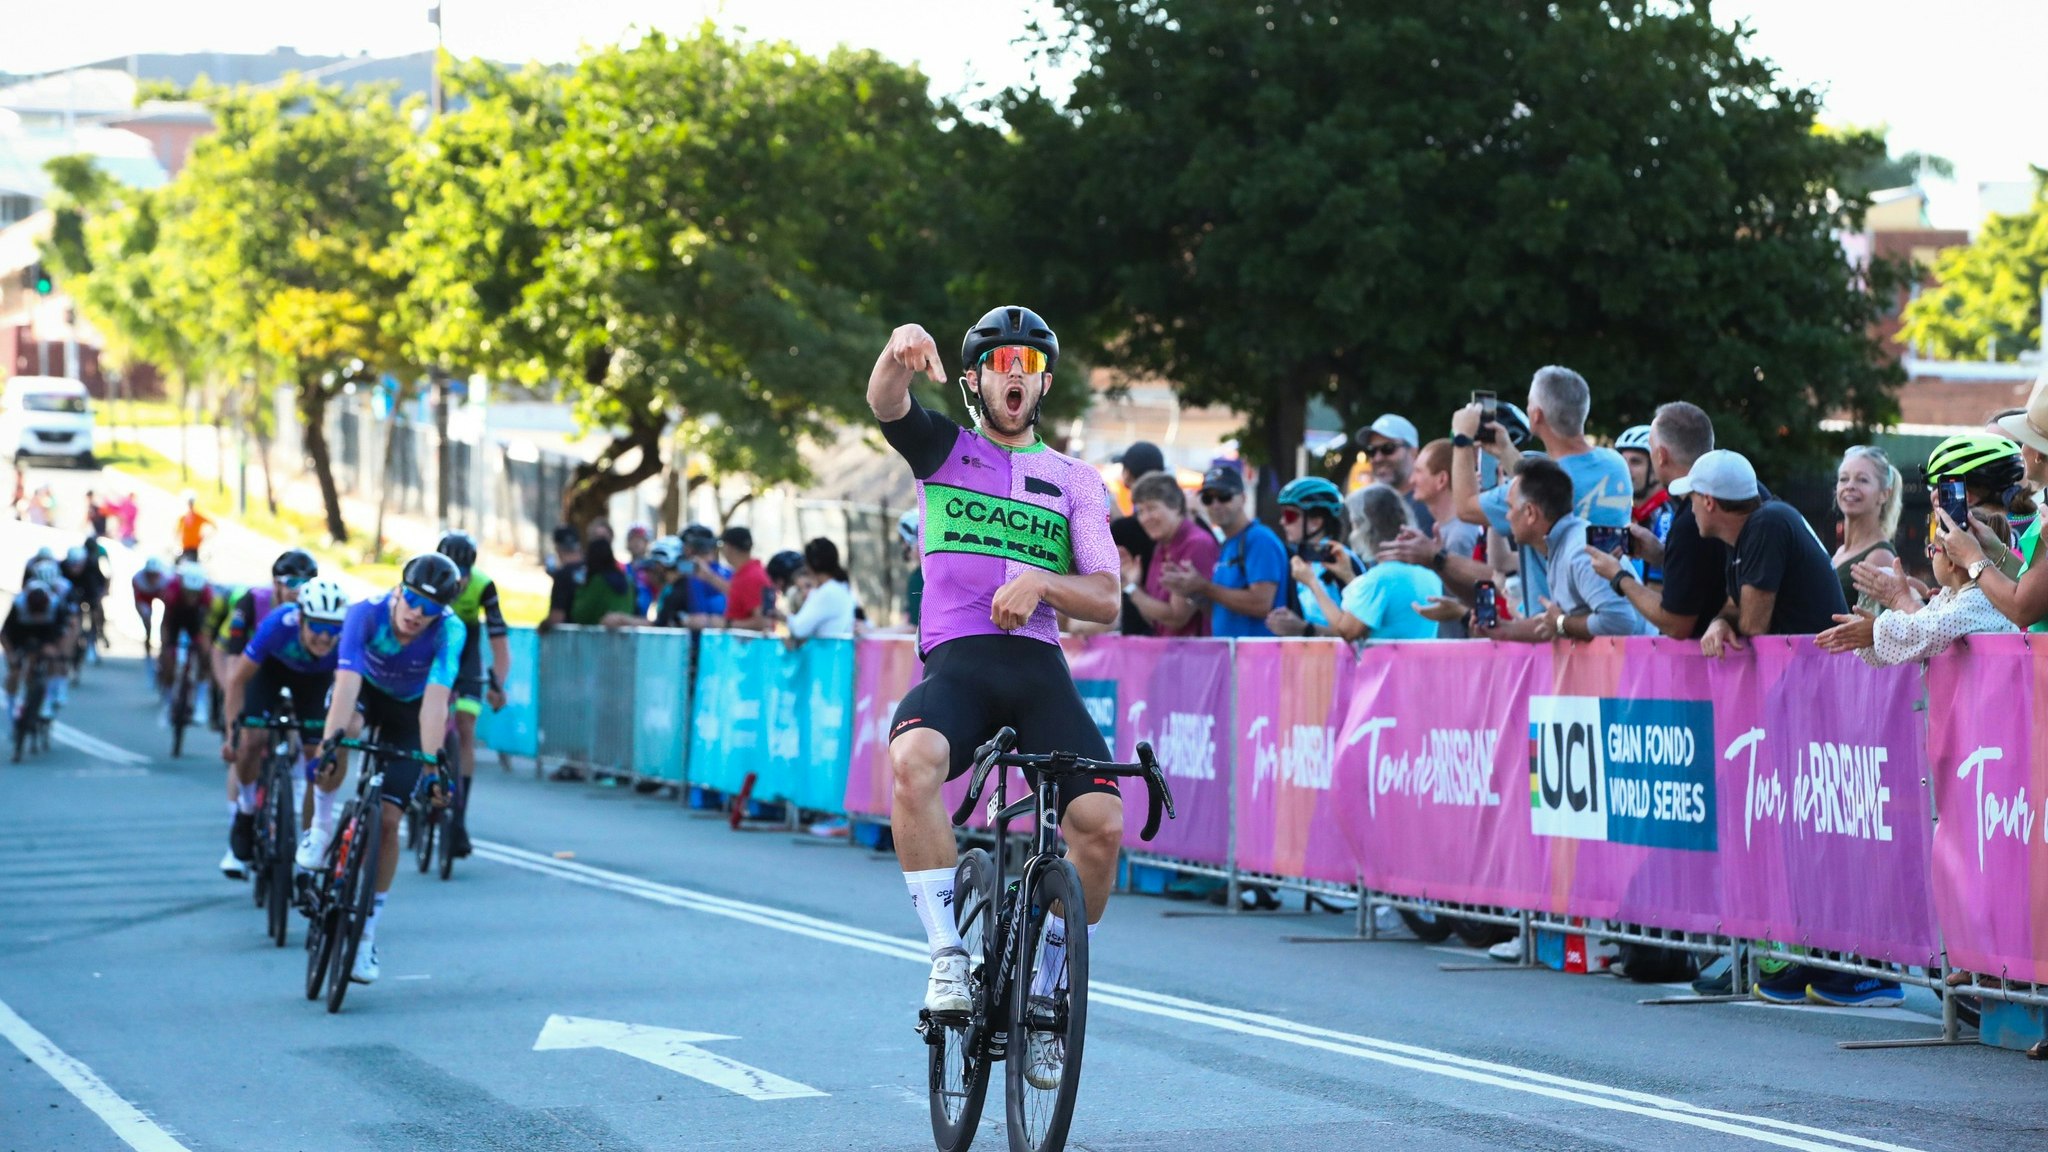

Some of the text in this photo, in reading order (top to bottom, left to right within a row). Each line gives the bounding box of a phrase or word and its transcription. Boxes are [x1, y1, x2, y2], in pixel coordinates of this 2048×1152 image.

[945, 497, 1064, 541] CCACHE
[1349, 716, 1413, 820] Tour
[1541, 722, 1598, 812] UCI
[1609, 777, 1706, 823] WORLD SERIES
[1724, 727, 1787, 851] Tour
[1957, 745, 2034, 874] Tour
